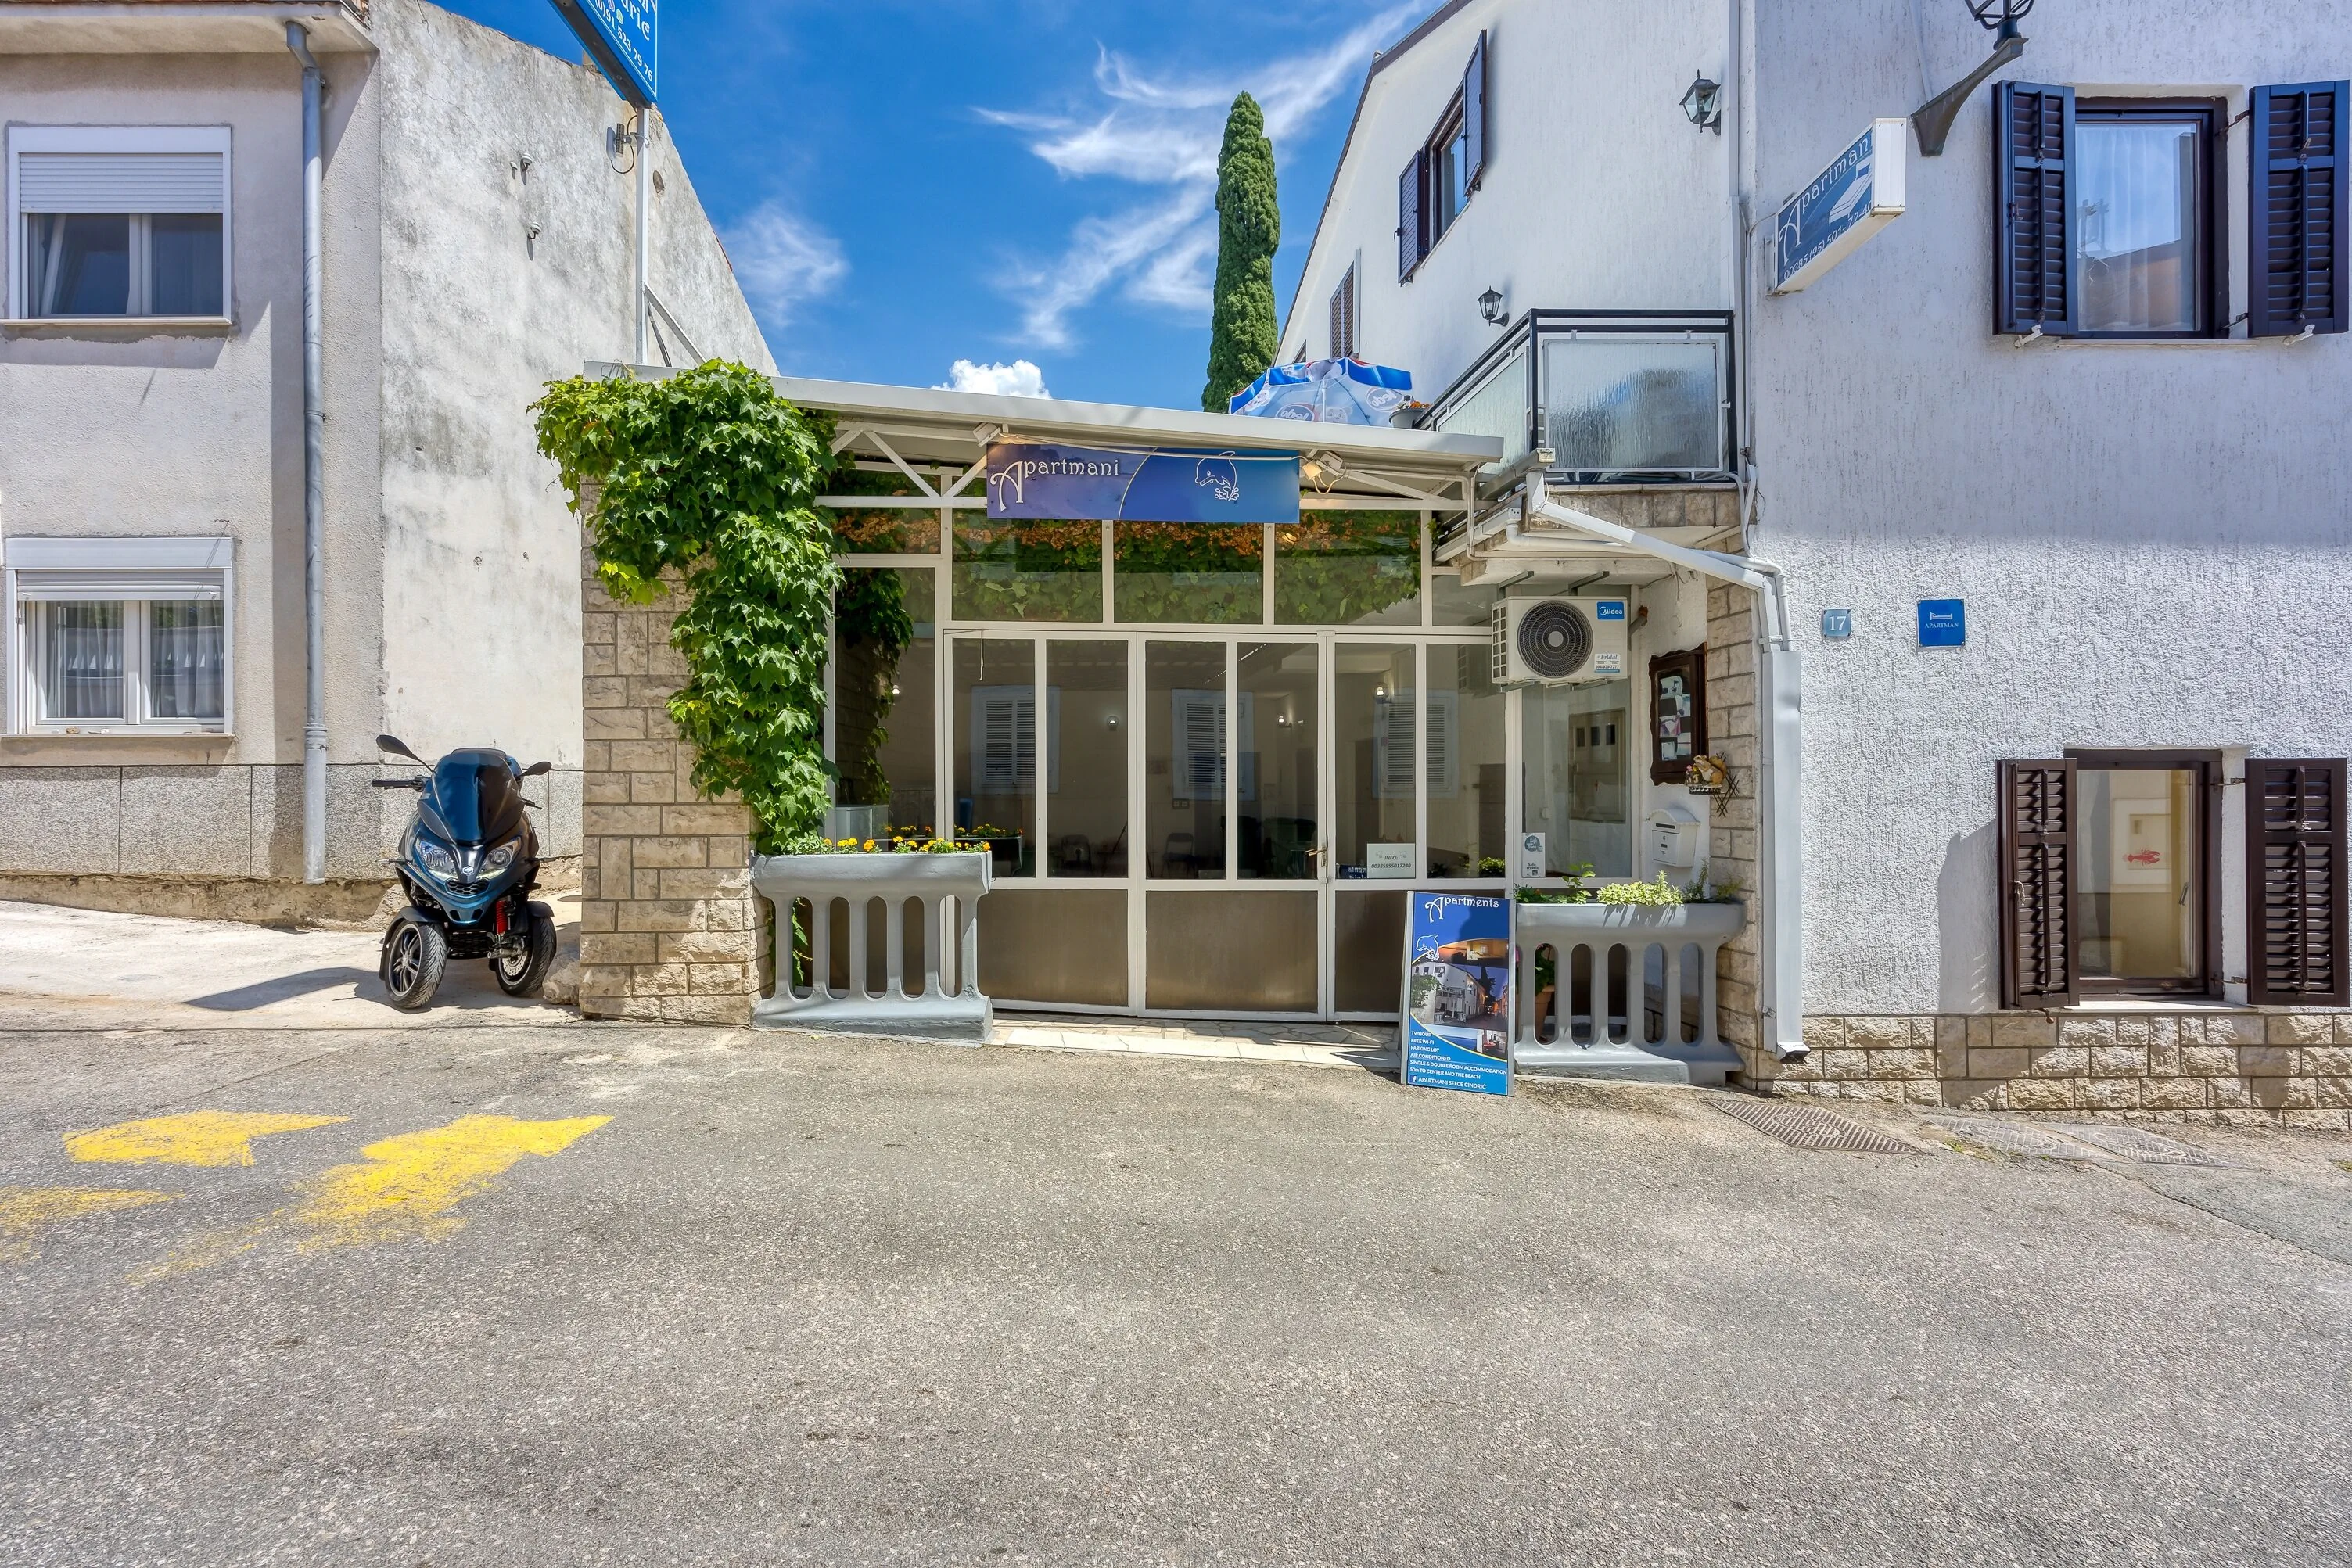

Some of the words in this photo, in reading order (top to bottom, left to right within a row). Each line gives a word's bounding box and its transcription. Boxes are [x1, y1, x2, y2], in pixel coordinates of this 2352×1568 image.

[617, 25, 631, 52] 523
[634, 47, 642, 66] 79
[644, 63, 653, 82] 76
[1779, 131, 1873, 267] Apartman
[989, 458, 1120, 513] Apartmani
[1830, 616, 1847, 631] 17
[1424, 897, 1499, 923] Apartments
[1464, 1065, 1507, 1075] ACCOMMODATION
